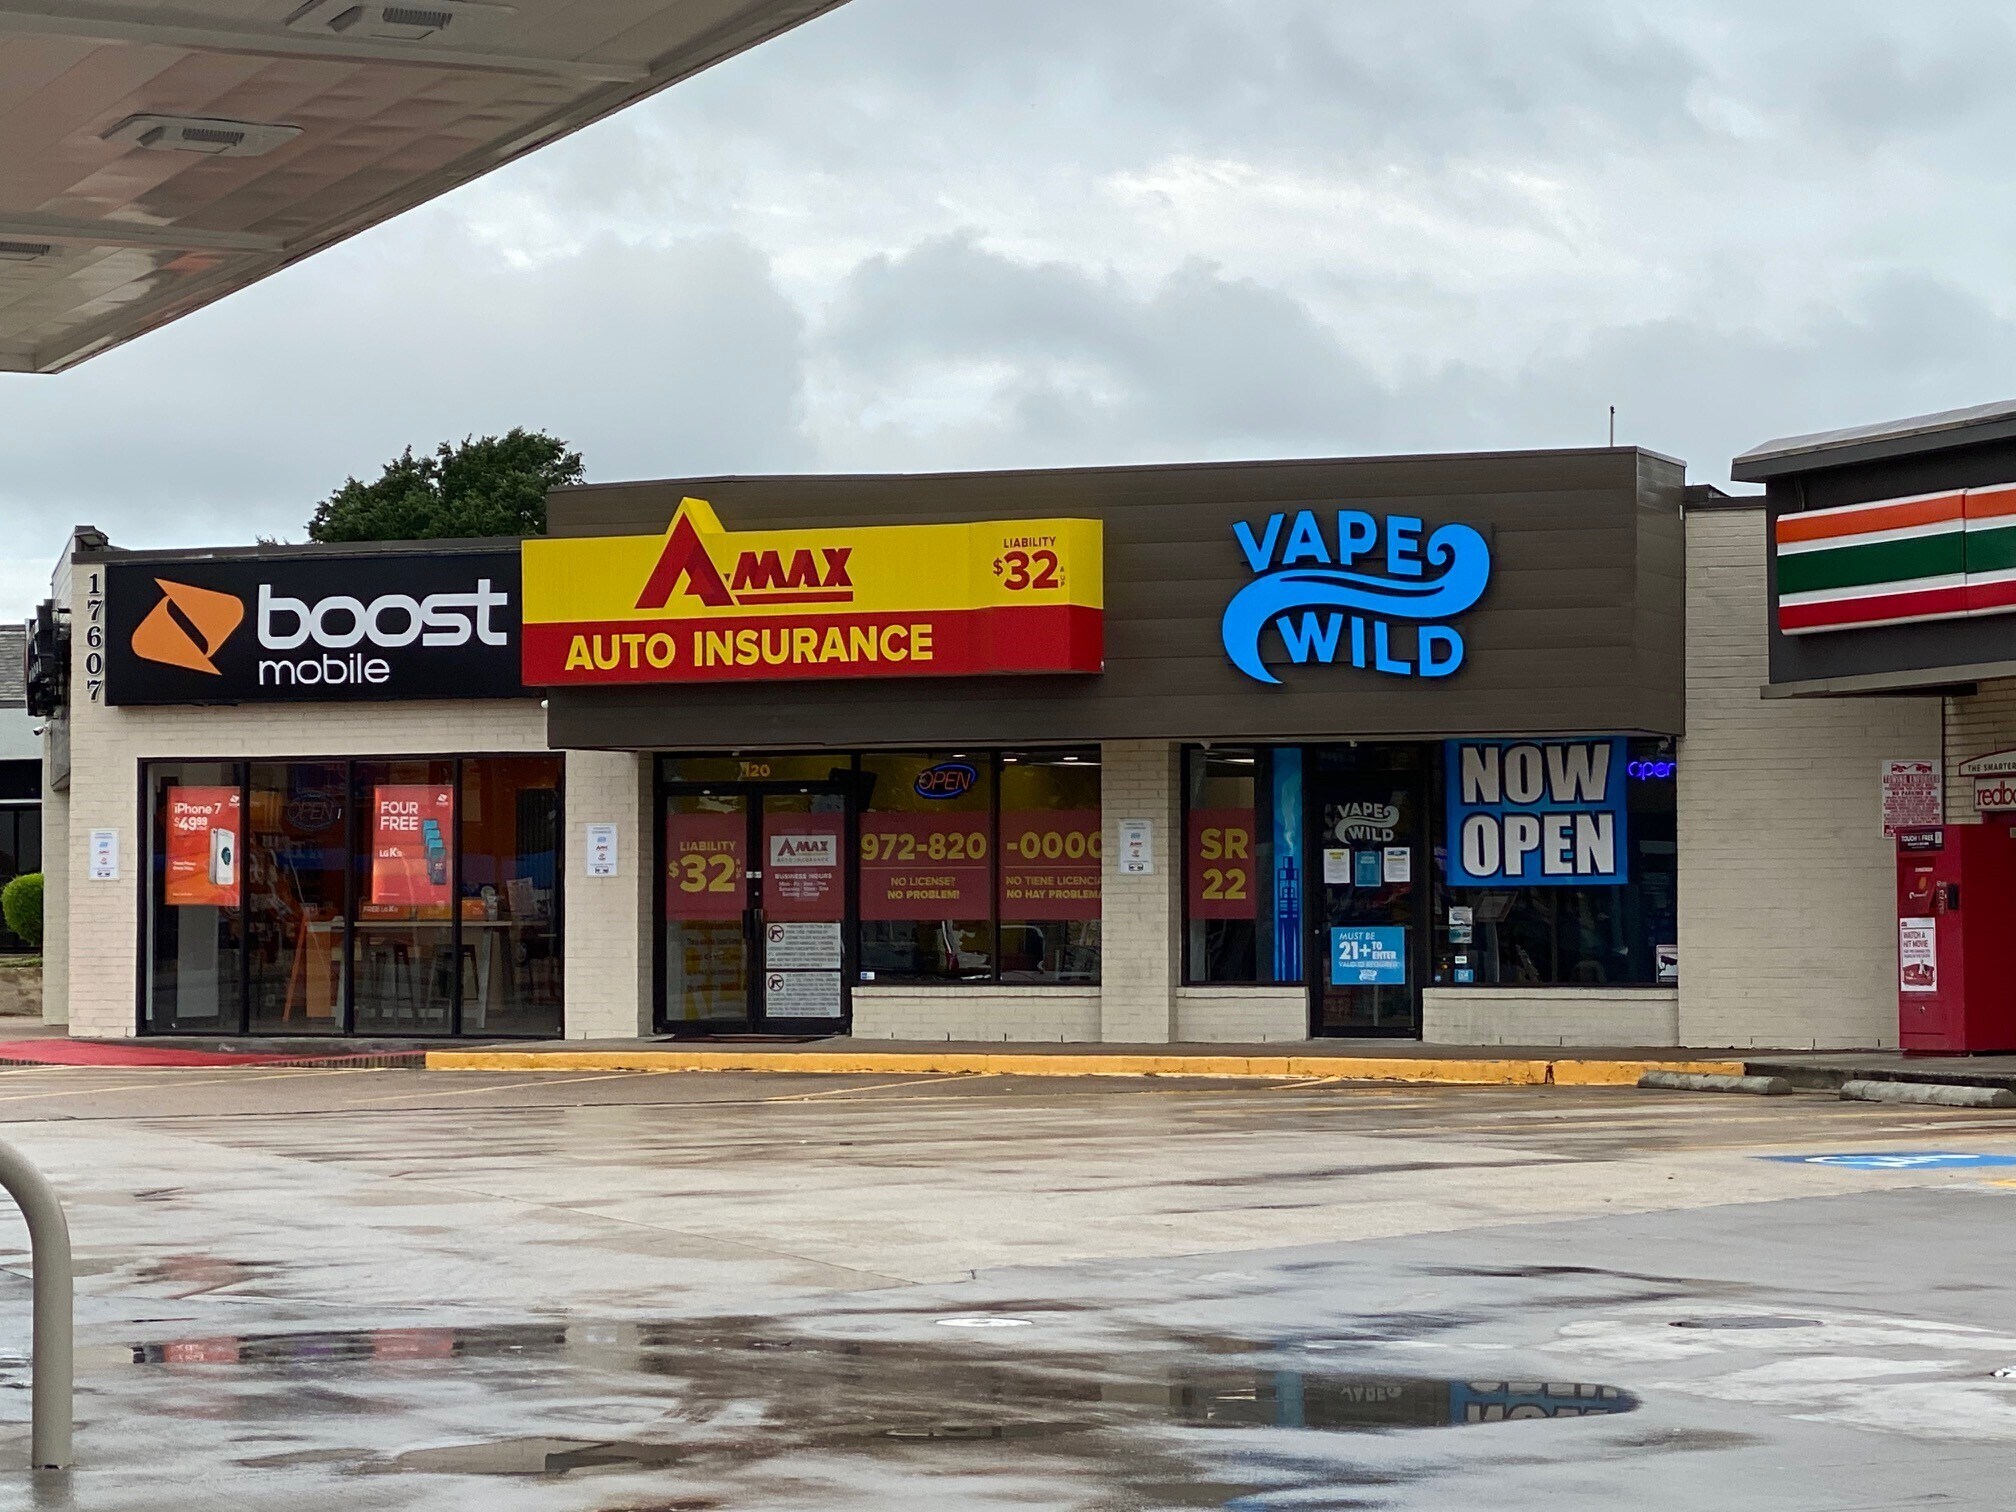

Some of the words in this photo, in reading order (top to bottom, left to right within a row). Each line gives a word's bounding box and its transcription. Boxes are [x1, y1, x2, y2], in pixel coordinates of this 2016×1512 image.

[1003, 537, 1056, 548] LIABILITY
[1232, 509, 1422, 576] VAPE
[993, 550, 1059, 590] $32
[257, 579, 508, 650] boost
[86, 573, 103, 702] 17607
[1276, 611, 1464, 677] WILD
[564, 632, 676, 671] AUTO
[694, 624, 934, 667] INSURANCE
[258, 653, 391, 686] mobile
[918, 771, 971, 790] OPEN
[1462, 744, 1611, 804] NOW
[1976, 780, 2016, 806] redb
[174, 802, 212, 814] iPhone
[214, 803, 222, 815] 7
[288, 801, 334, 820] OPEN
[380, 801, 419, 815] FOUR
[1338, 802, 1383, 818] VAPE
[380, 816, 419, 831] FREE
[1348, 826, 1394, 842] WILD
[680, 841, 736, 851] LIABILITY
[860, 832, 987, 860] 972-820
[1200, 828, 1249, 860] SR
[1462, 813, 1615, 876] OPEN
[668, 854, 736, 893] $32
[890, 877, 906, 886] NO
[909, 876, 956, 886] LICENSE?
[1006, 876, 1022, 886] NO
[1024, 876, 1053, 885] TIENE
[1202, 868, 1247, 900] 22
[887, 890, 903, 899] NO
[906, 889, 960, 899] PROBLEM!
[1007, 889, 1022, 899] NO
[1025, 889, 1046, 899] HAY
[1339, 931, 1364, 940] MUST
[1365, 931, 1376, 940] BE
[1921, 931, 1926, 939] A
[1339, 941, 1371, 960] 21+
[1372, 941, 1383, 950] TO
[1372, 950, 1397, 960] ENTER
